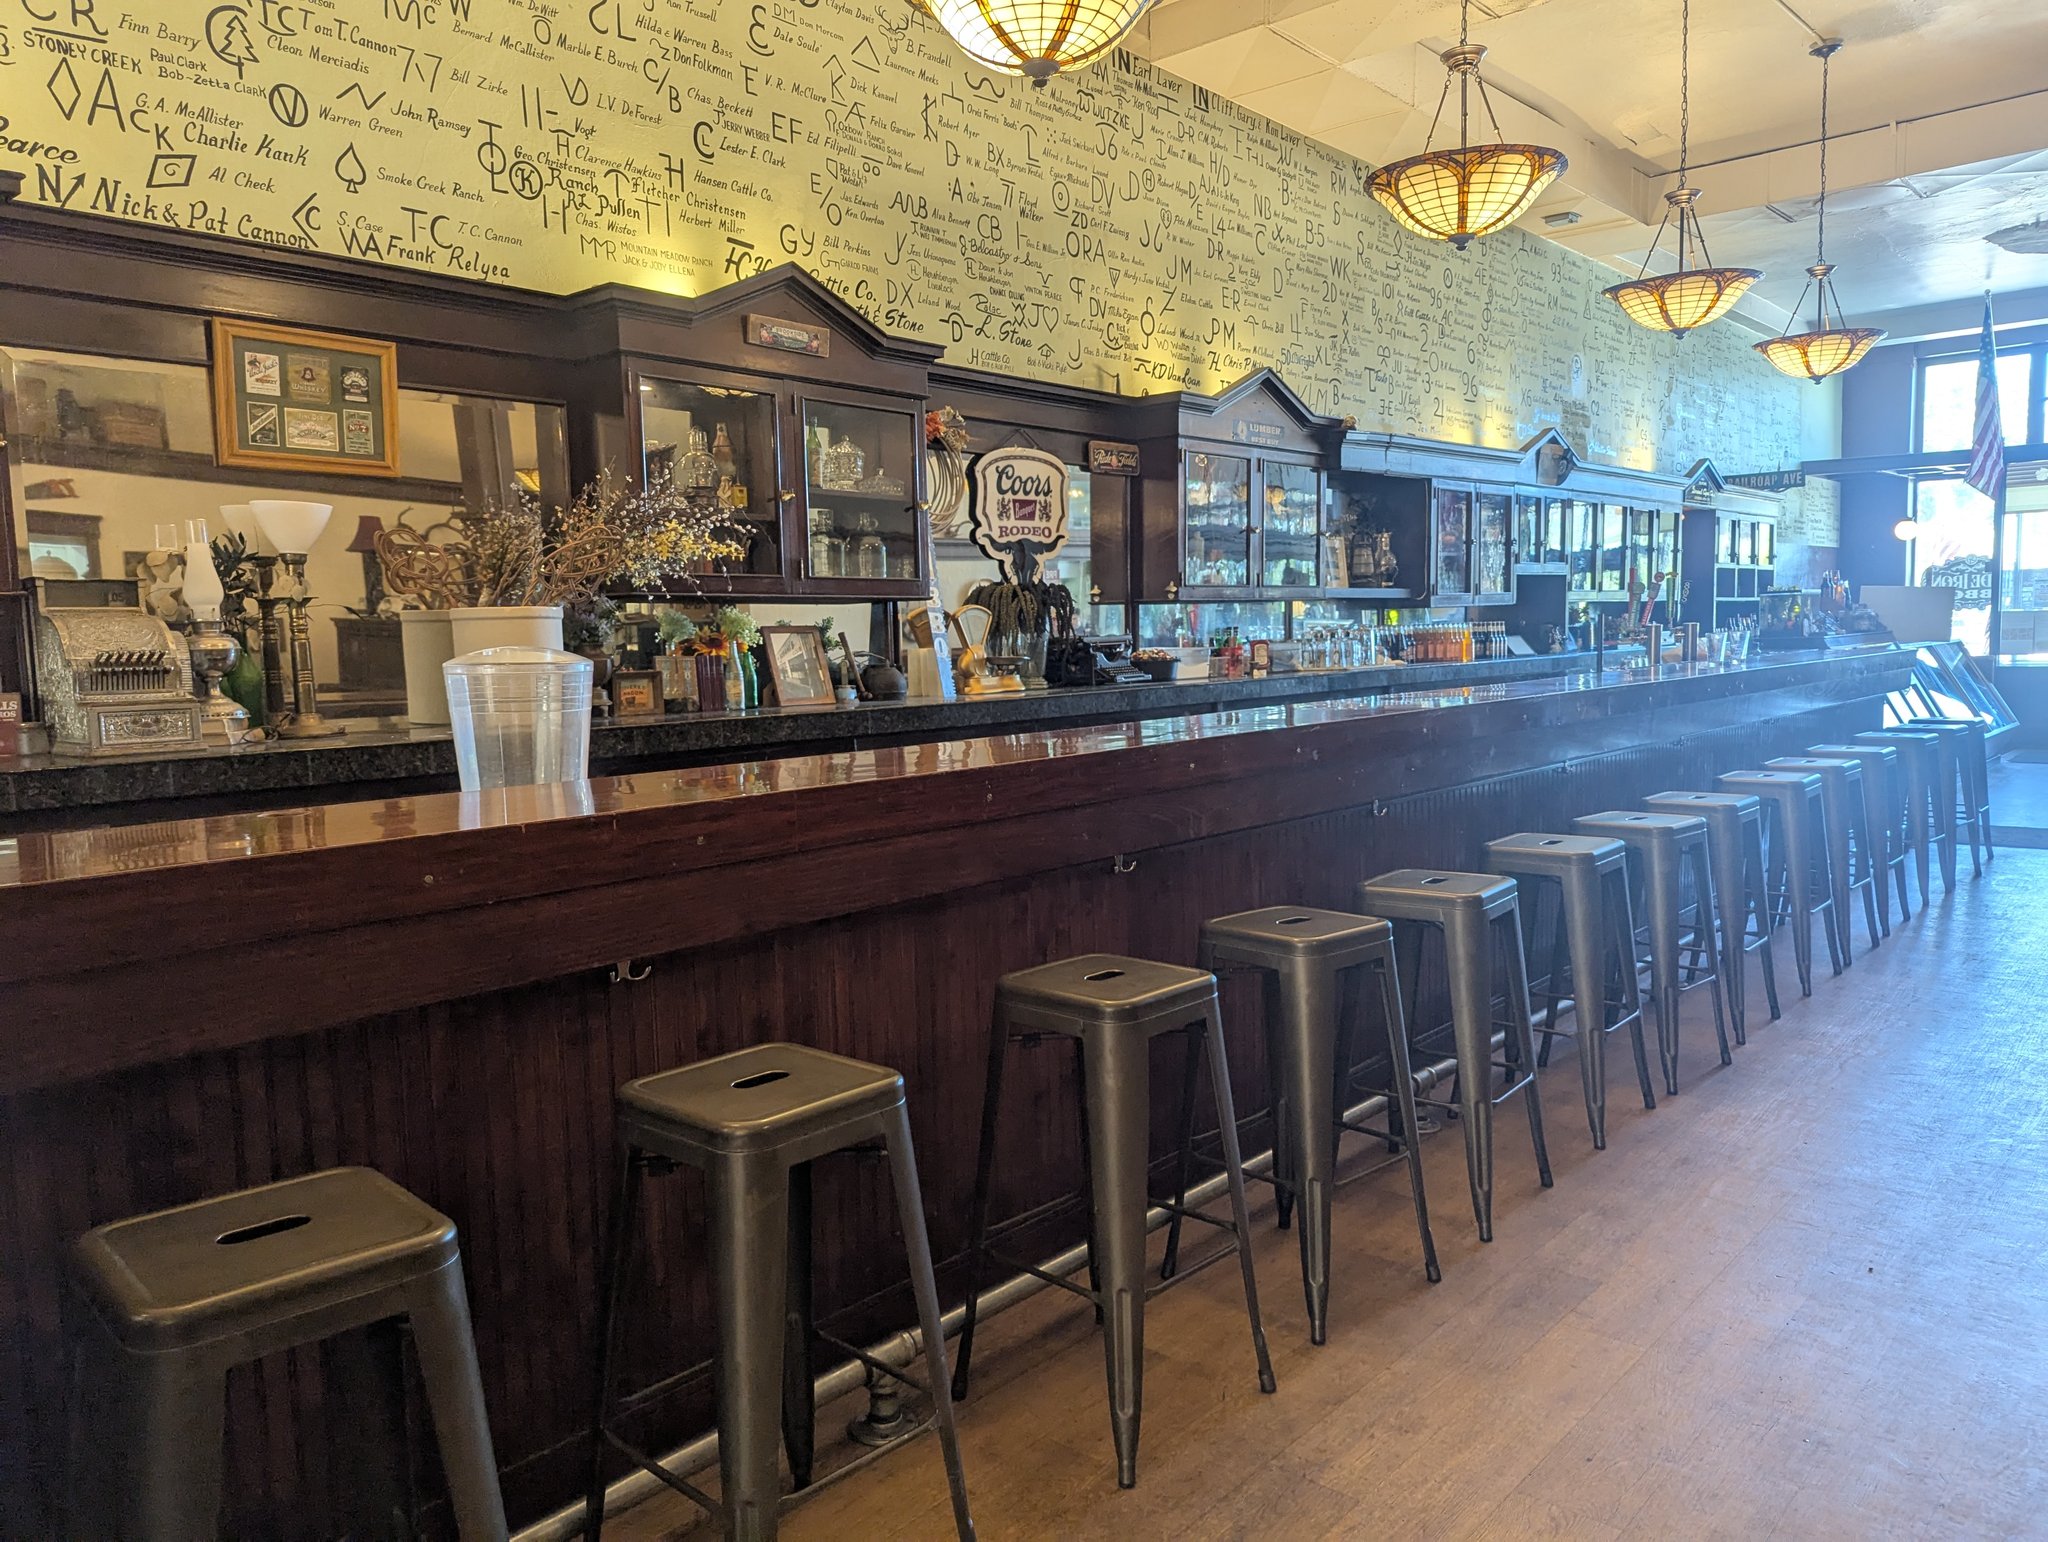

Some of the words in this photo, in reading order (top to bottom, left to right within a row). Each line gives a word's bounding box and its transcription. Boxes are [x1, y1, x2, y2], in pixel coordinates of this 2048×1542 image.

[685, 1, 717, 23] Trussell
[855, 8, 875, 25] Davis
[118, 13, 149, 36] Finn
[156, 23, 201, 52] Barry
[298, 7, 333, 38] Tom
[350, 25, 397, 57] Cannon
[452, 19, 493, 43] Bernard
[500, 34, 555, 62] McCallister
[635, 14, 663, 37] Hilda
[673, 27, 707, 51] Warren
[711, 39, 734, 59] Bass
[773, 27, 793, 44] Dale
[24, 30, 87, 60] STONEY
[91, 49, 142, 74] CREEK
[150, 48, 175, 65] Paul
[177, 55, 208, 72] Clark
[267, 35, 303, 57] Cleon
[309, 45, 370, 74] Merciadis
[556, 33, 591, 57] Marble
[607, 50, 639, 74] Burch
[672, 46, 692, 66] Don
[692, 53, 734, 81] Folkman
[450, 68, 470, 85] Bill
[477, 75, 509, 96] Zirke
[884, 55, 916, 77] Laurence
[918, 68, 939, 86] Meeks
[1132, 56, 1152, 81] Earl
[1156, 67, 1182, 93] Laver
[791, 83, 827, 104] McClure
[850, 76, 867, 94] Dick
[154, 97, 169, 114] A.
[175, 101, 244, 130] McAllister
[687, 87, 713, 106] Chas.
[715, 96, 754, 118] Beckett
[1010, 97, 1022, 111] Bill
[1025, 101, 1055, 124] Thompson
[319, 104, 362, 129] Warren
[369, 118, 403, 139] Green
[391, 100, 423, 123] John
[427, 107, 472, 139] Ramsey
[721, 120, 743, 136] JERRY
[870, 116, 887, 130] Felix
[938, 114, 960, 131] Robert
[963, 123, 980, 139] Ayer
[183, 122, 248, 153] Charlie
[806, 131, 820, 146] Ed
[1059, 131, 1072, 146] Jack
[1280, 124, 1301, 148] Laver
[514, 145, 535, 164] Geo.
[537, 151, 597, 179] Christensen
[575, 145, 622, 170] Clarence
[624, 157, 662, 181] Hawkins
[719, 136, 748, 157] Lester
[762, 149, 787, 169] Clark
[208, 166, 227, 183] Al
[234, 171, 277, 194] Check
[377, 166, 413, 187] Smoke
[417, 175, 446, 195] Creek
[452, 182, 485, 203] Ranch
[693, 169, 728, 191] Hansen
[731, 178, 759, 198] Cattle
[90, 177, 157, 220] Nick
[162, 203, 181, 228] &
[187, 200, 228, 234] Pat
[237, 214, 310, 249] Cannon
[686, 191, 746, 220] Christensen
[931, 207, 946, 222] Alva
[1019, 206, 1045, 223] Walker
[355, 215, 384, 234] Case
[679, 208, 713, 229] Herbert
[718, 216, 746, 235] Miller
[485, 227, 523, 247] Cannon
[823, 234, 840, 250] Bill
[843, 239, 872, 257] Perkins
[387, 235, 436, 264] Frank
[447, 245, 510, 281] Relyea
[620, 240, 658, 258] MOUNTAIN
[660, 250, 690, 265] MEADOW
[622, 256, 642, 268] JACK
[855, 280, 877, 302] Co.
[945, 298, 961, 312] Wood
[885, 308, 925, 334] Stone
[1000, 320, 1033, 349] Stone
[1250, 423, 1281, 435] LUMBER
[996, 464, 1053, 498] Coors
[1783, 472, 1803, 485] AVE
[998, 525, 1053, 539] RODEO
